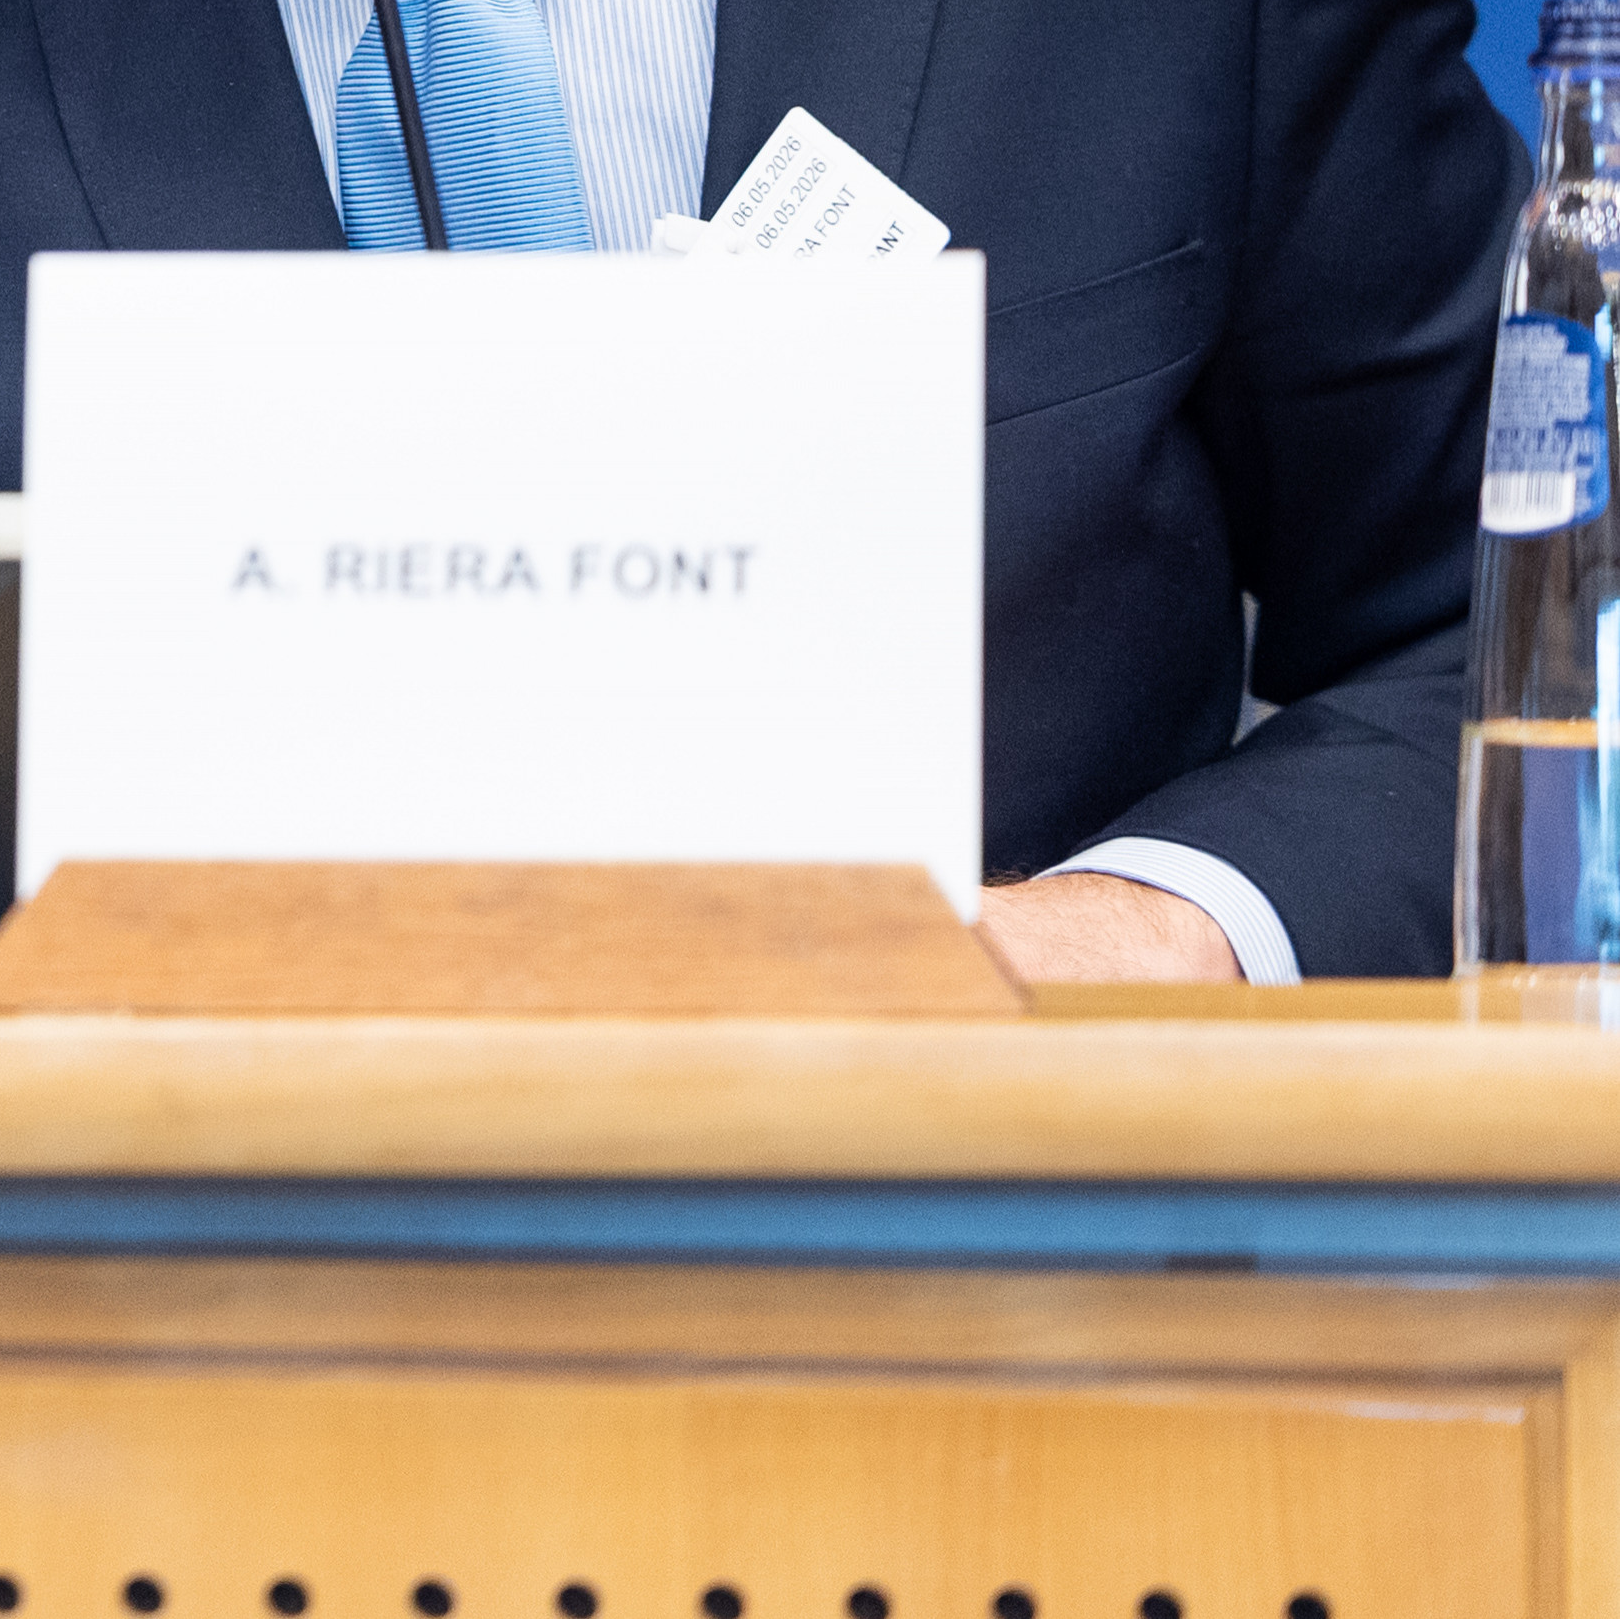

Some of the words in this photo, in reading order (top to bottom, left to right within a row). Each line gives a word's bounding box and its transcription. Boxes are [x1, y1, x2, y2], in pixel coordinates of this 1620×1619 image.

[731, 136, 802, 227] 06.05.2026
[755, 157, 827, 250] 06.05.2026
[815, 184, 856, 237] FONT
[225, 540, 297, 601] A.
[320, 539, 544, 601] RIERA
[565, 539, 759, 601] FONT
